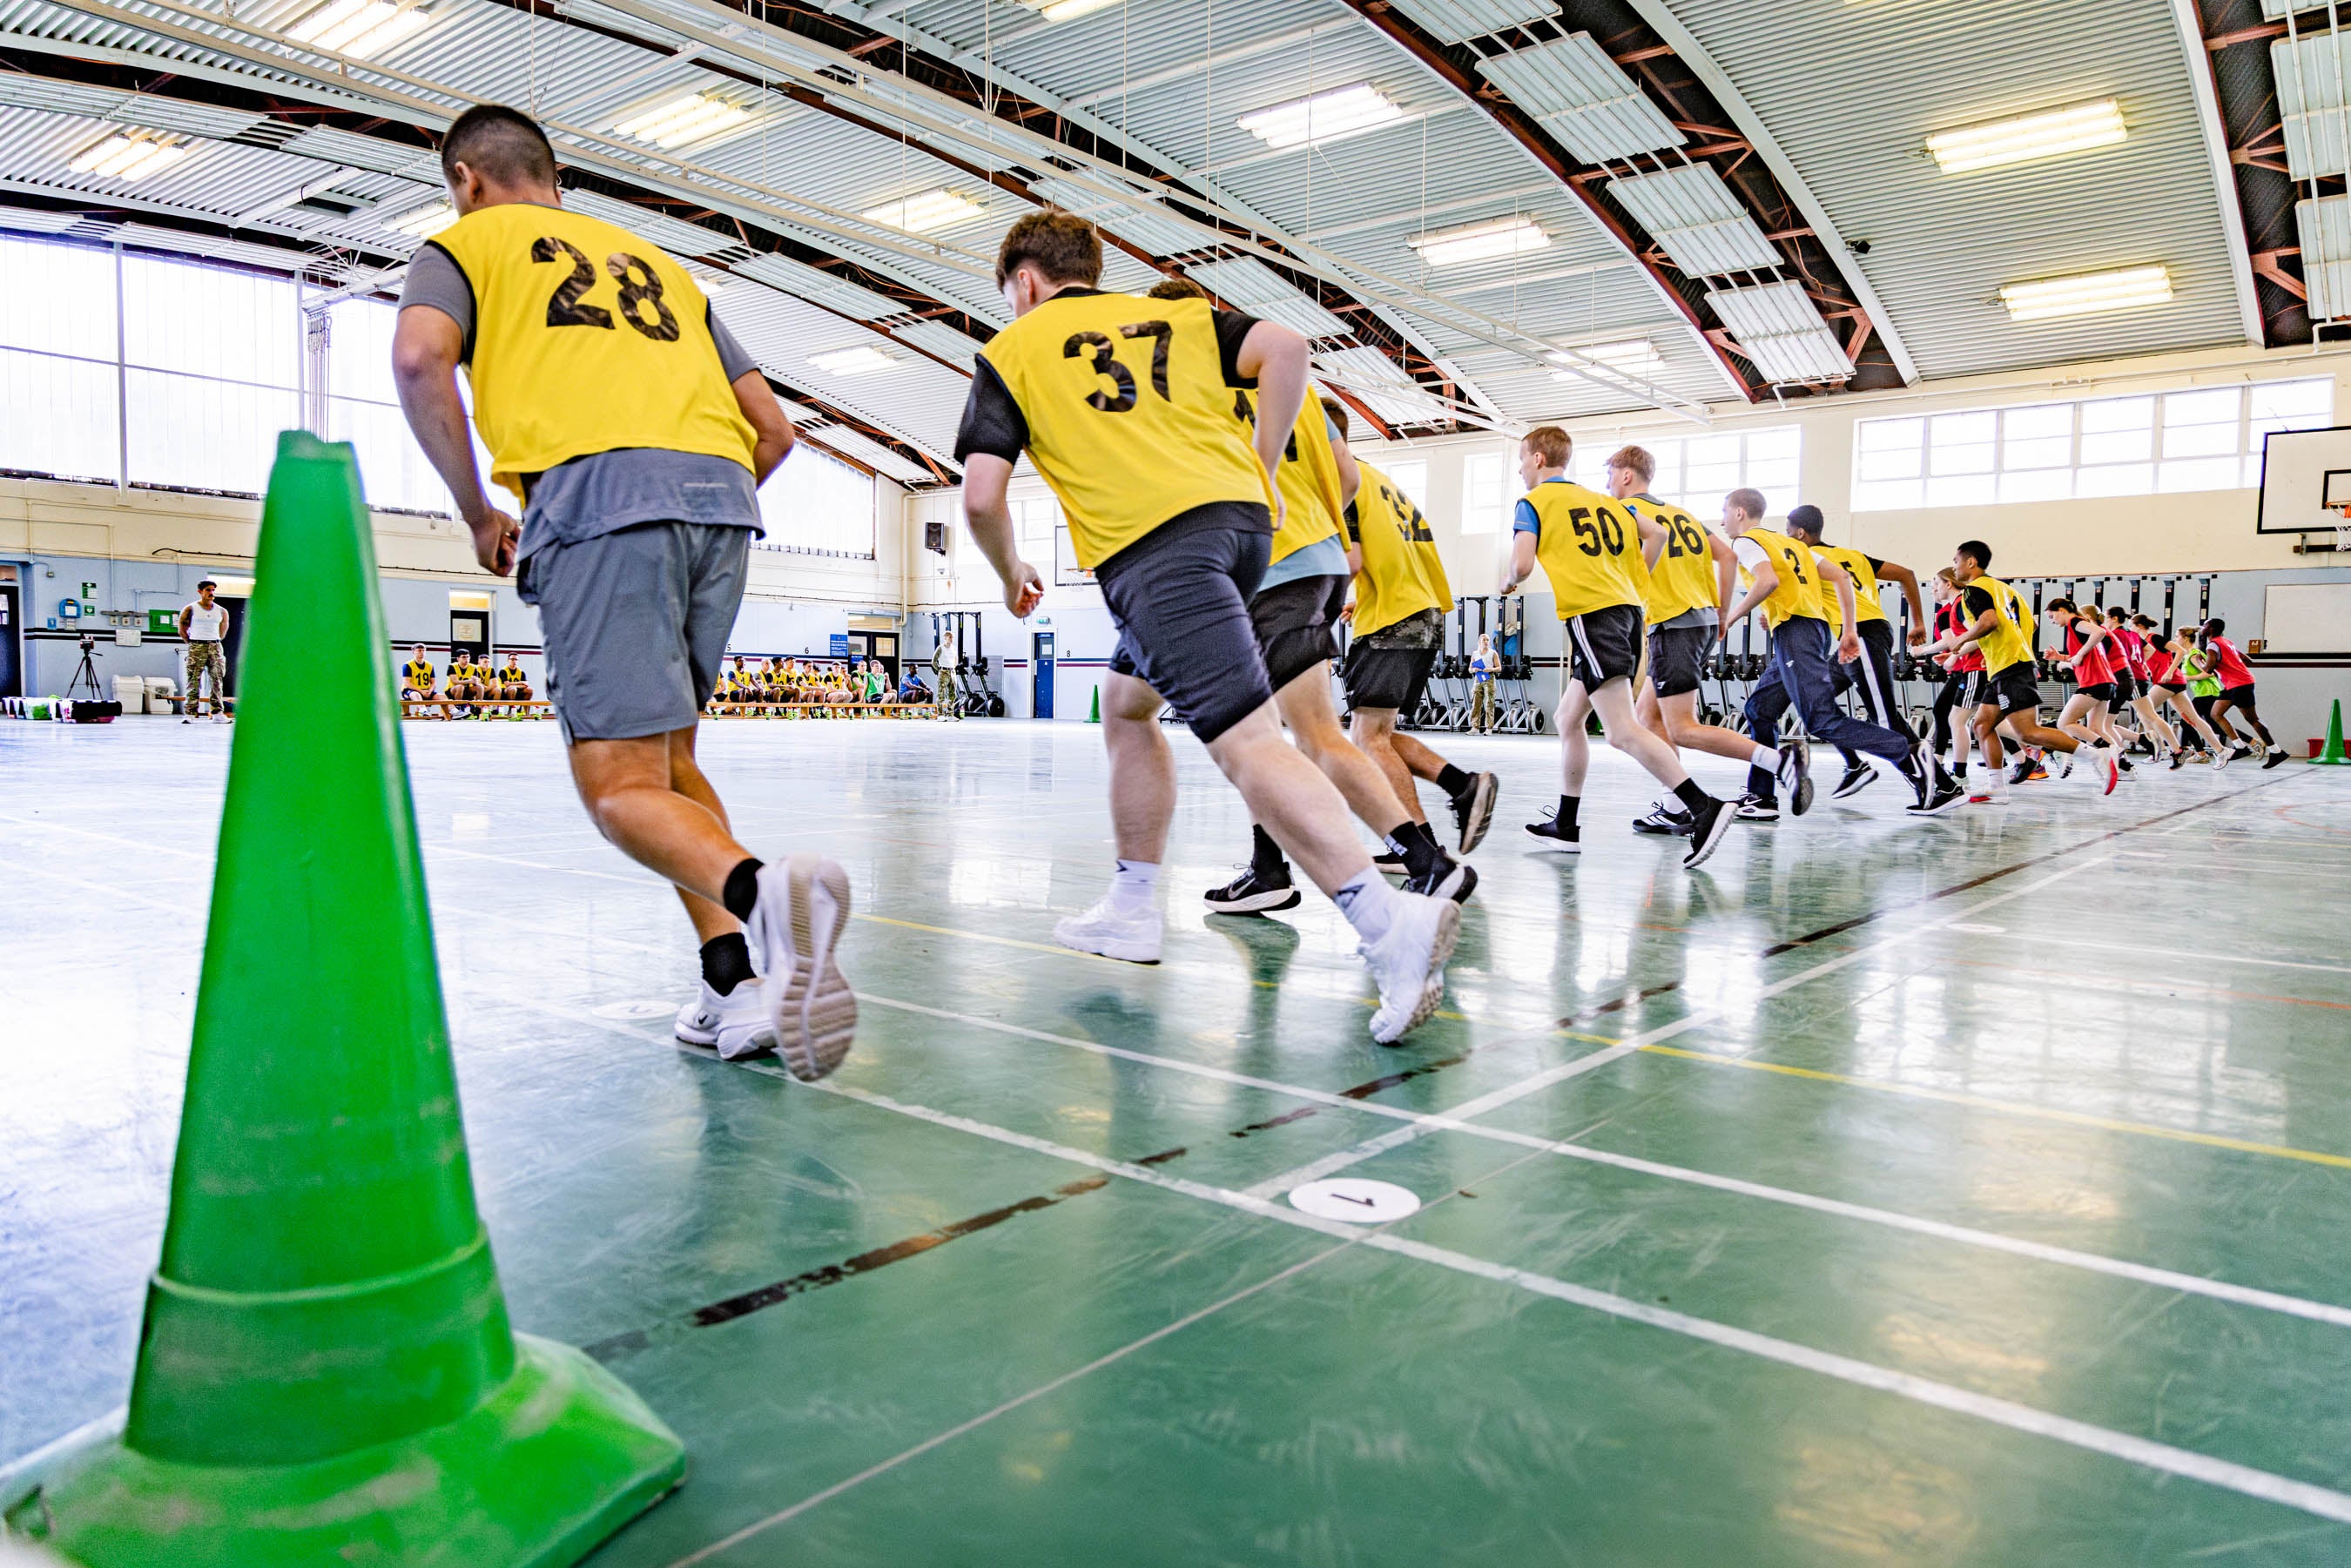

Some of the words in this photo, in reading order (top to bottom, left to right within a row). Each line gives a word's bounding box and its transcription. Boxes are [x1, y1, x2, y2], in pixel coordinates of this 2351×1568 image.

[530, 236, 680, 342] 28
[1063, 320, 1173, 413] 37
[1568, 507, 1625, 557] 50
[1655, 514, 1704, 558] 26
[1784, 548, 1808, 585] 2
[726, 643, 731, 652] 5
[1066, 649, 1071, 658] 8
[415, 672, 430, 686] 19
